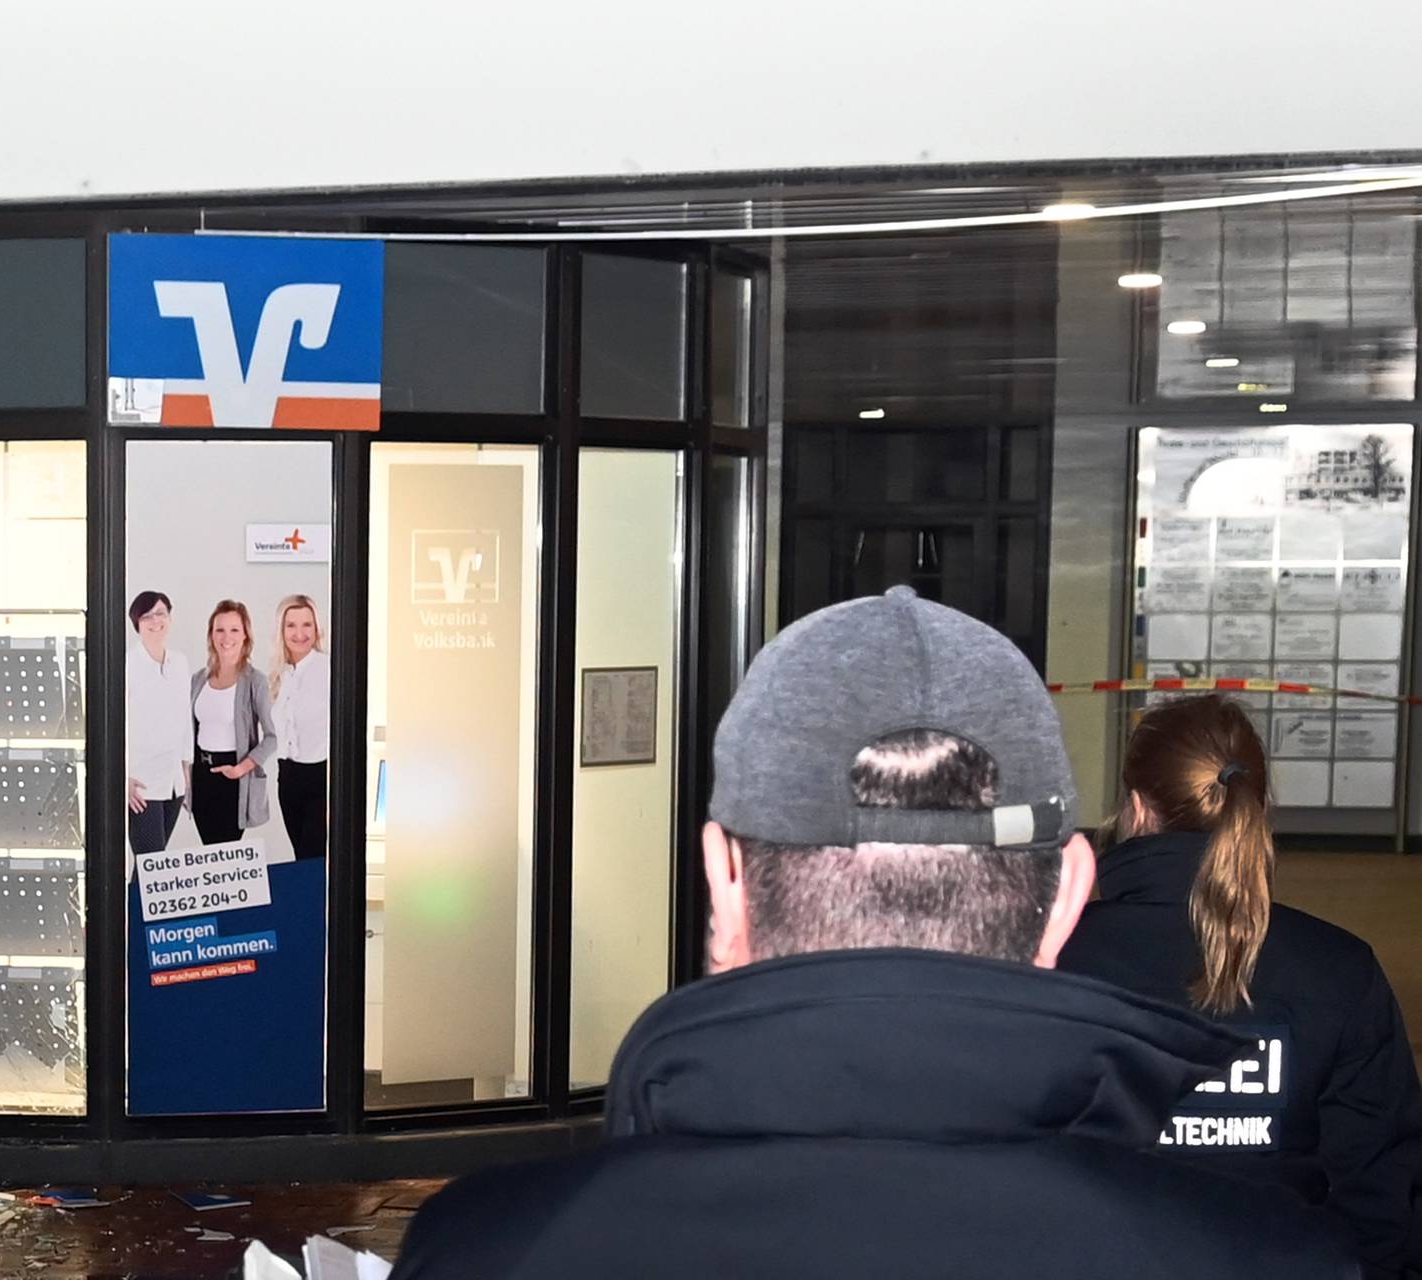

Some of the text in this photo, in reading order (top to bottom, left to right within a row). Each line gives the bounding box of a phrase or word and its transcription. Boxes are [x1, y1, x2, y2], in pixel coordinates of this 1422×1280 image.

[143, 847, 259, 872] Gute Beratung,
[146, 867, 263, 894] starker Service:
[148, 889, 248, 915] 02362 204-0
[149, 924, 215, 944] Morgen
[151, 937, 274, 966] kann kommen.
